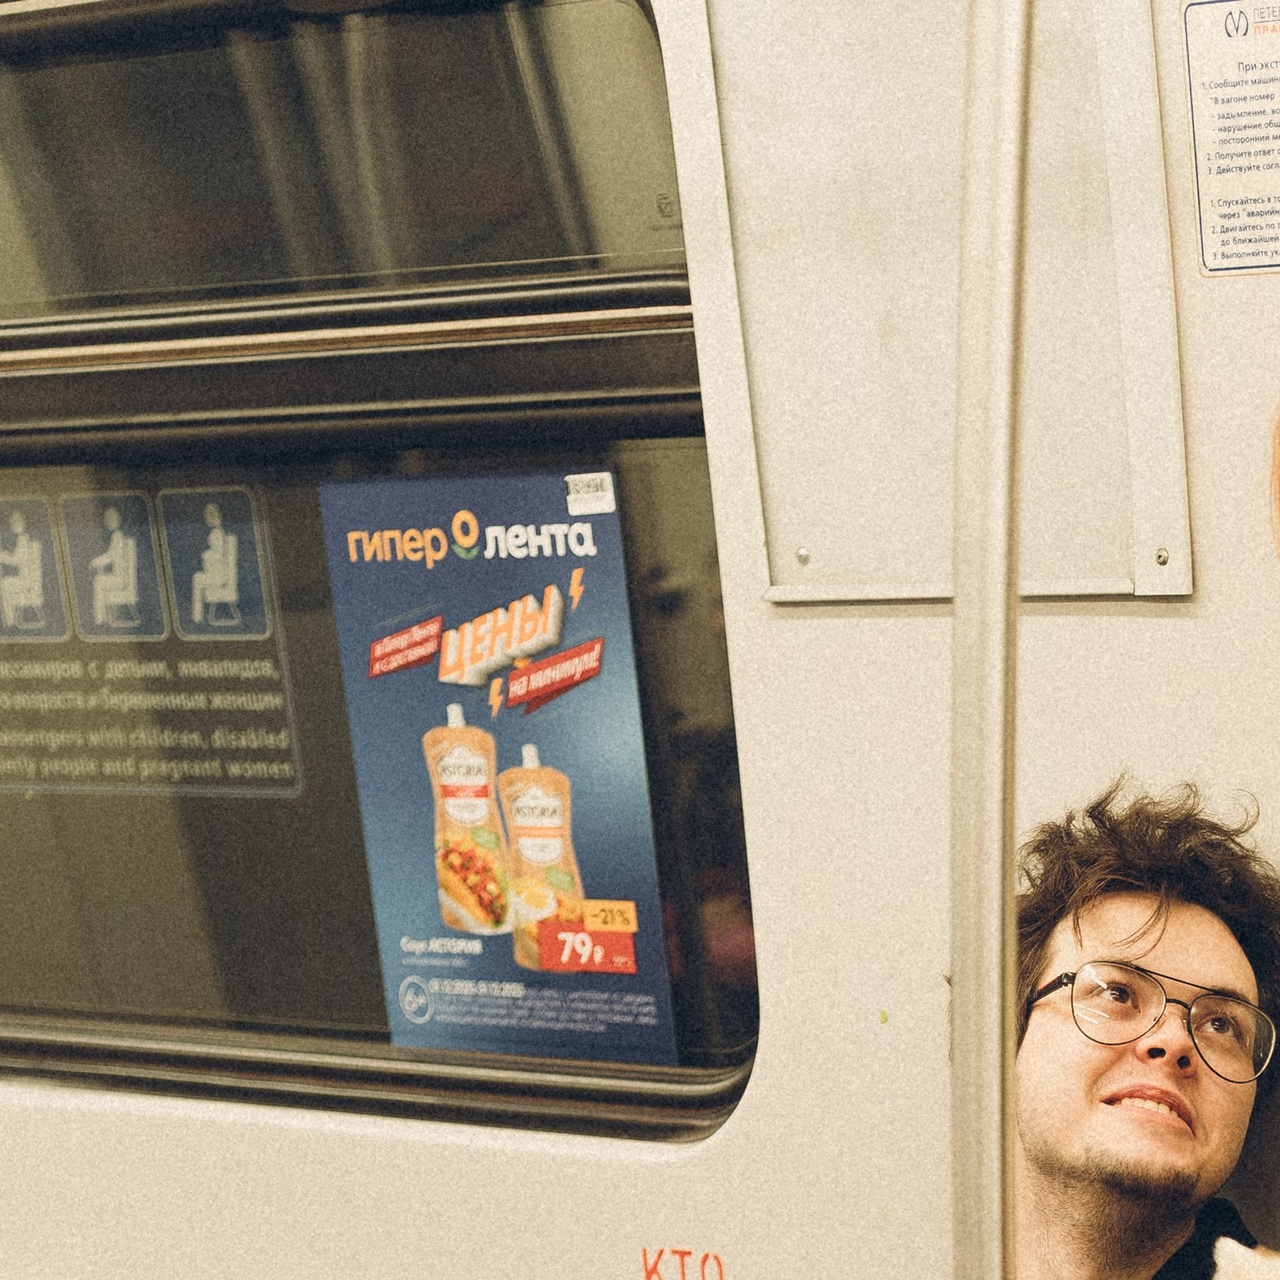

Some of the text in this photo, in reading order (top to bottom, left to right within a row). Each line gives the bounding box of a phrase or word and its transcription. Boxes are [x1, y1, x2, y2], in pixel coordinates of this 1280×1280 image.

[1238, 62, 1257, 74] При
[1208, 77, 1249, 90] Сообщите
[1222, 95, 1248, 104] вагоне
[1249, 92, 1275, 103] номер
[1218, 121, 1262, 134] нарушение
[1219, 133, 1270, 146] посторонний
[1214, 149, 1252, 162] Получите
[1253, 148, 1275, 158] ответ
[1215, 162, 1261, 175] Действуйте
[1217, 196, 1265, 209] Спускайтесь
[1218, 211, 1241, 222] через
[1220, 222, 1264, 235] Двигайтесь
[1265, 222, 1275, 230] по
[1221, 238, 1230, 247] до
[1232, 233, 1280, 246] ближайшей
[1220, 247, 1268, 260] Выполняйте
[347, 522, 598, 569] гипер лента
[439, 584, 563, 687] ЦЕНЫ
[508, 675, 528, 699] на
